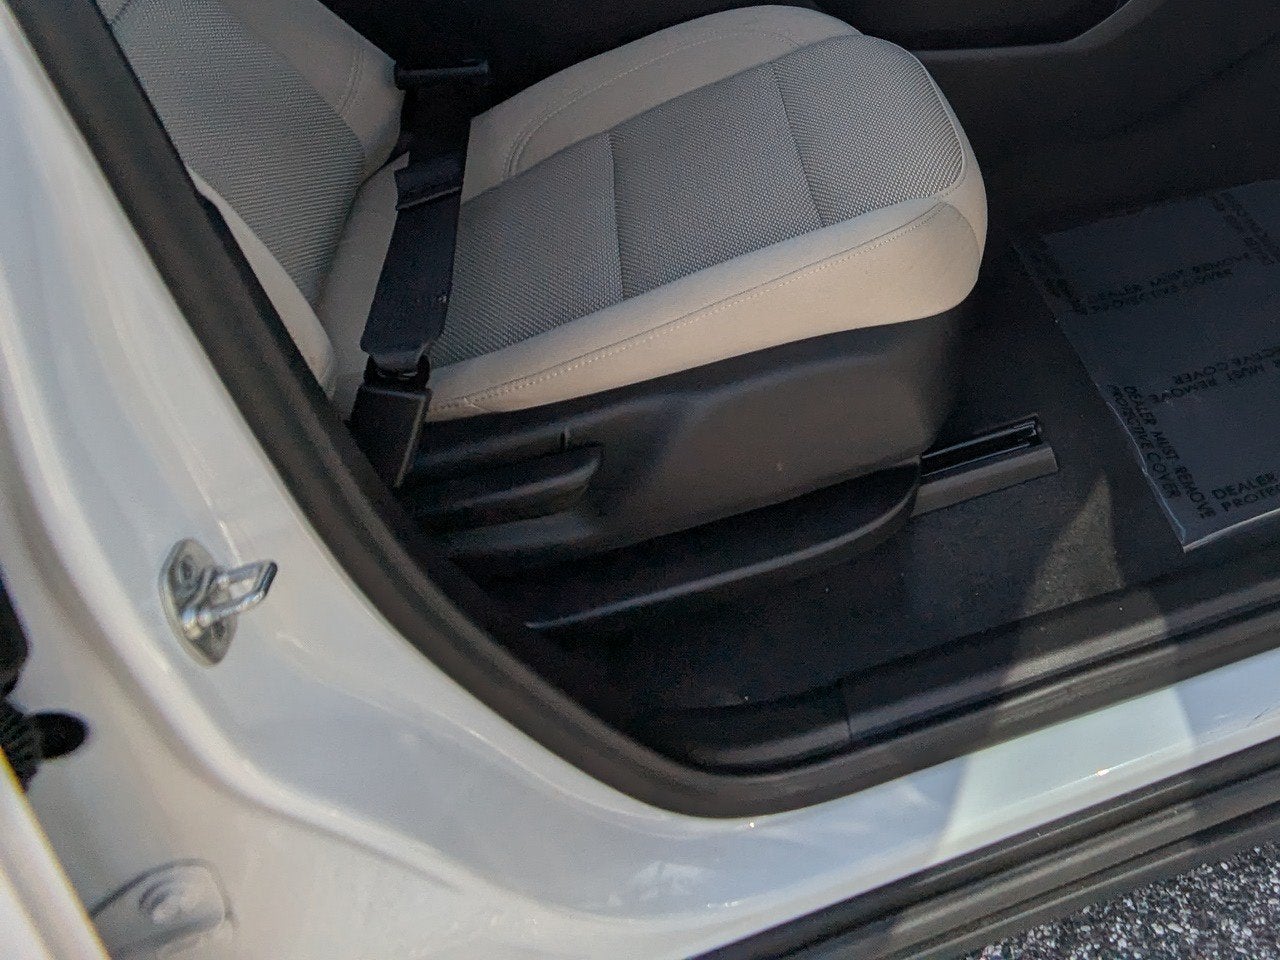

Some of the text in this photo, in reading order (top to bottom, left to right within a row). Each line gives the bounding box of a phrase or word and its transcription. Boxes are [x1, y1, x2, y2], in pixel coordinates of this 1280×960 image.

[1171, 361, 1229, 386] COVER
[1147, 376, 1218, 404] REMOVE
[1123, 385, 1217, 520] DEALER MUST REMOVE
[1147, 452, 1182, 500] COVER
[1211, 472, 1278, 501] DEALER
